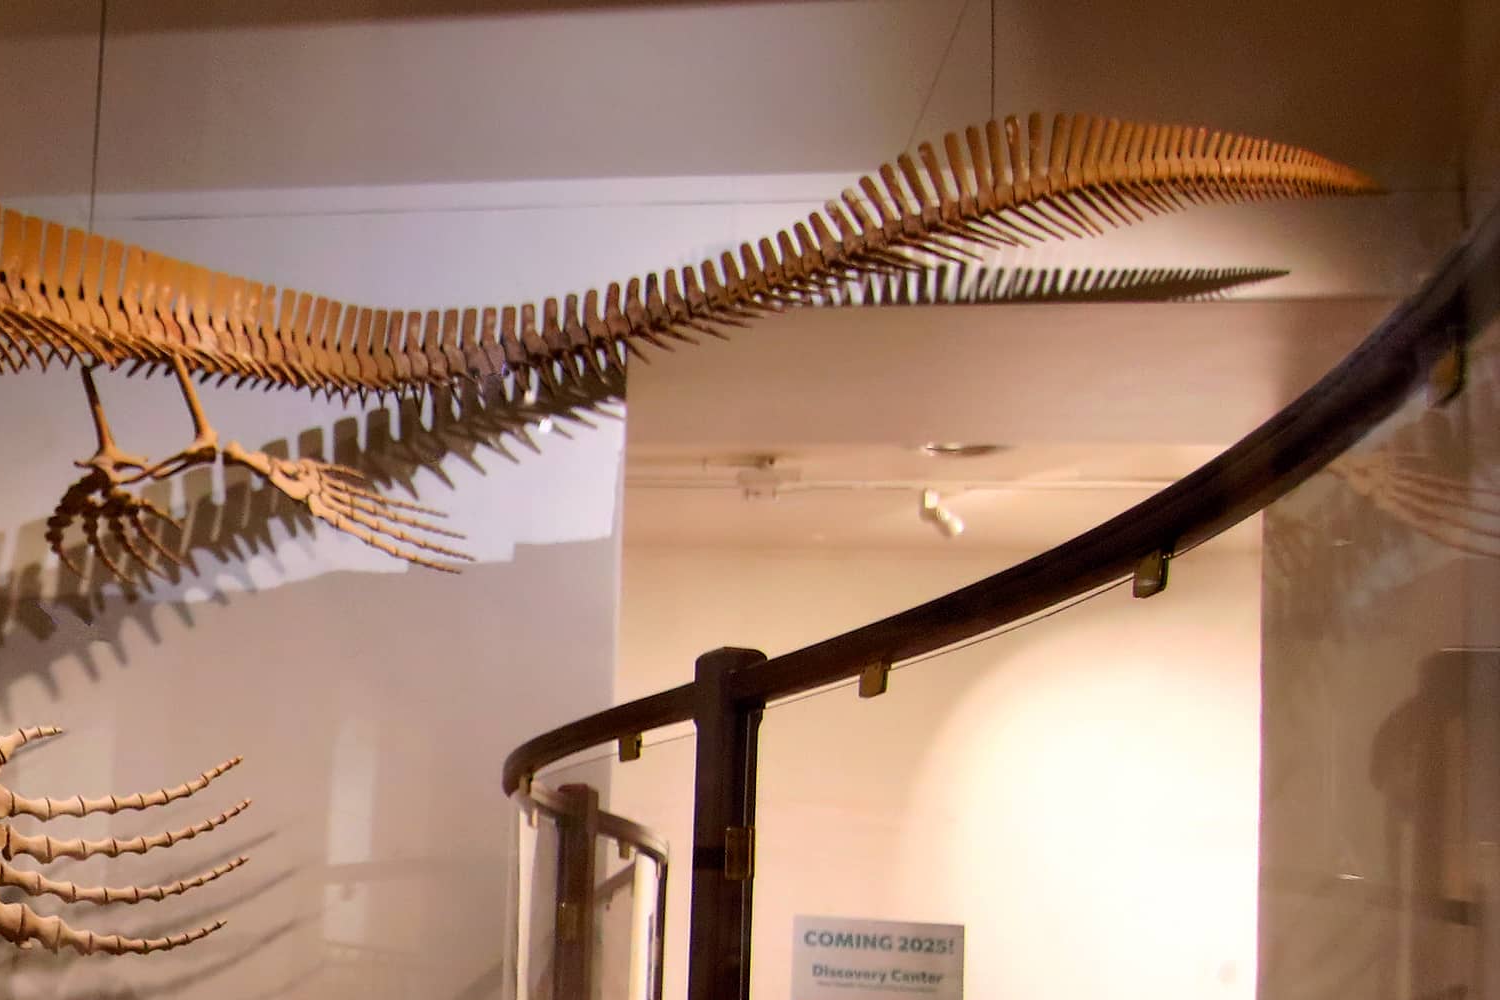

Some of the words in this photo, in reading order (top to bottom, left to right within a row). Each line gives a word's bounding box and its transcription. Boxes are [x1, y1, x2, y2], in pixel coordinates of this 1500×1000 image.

[803, 930, 893, 950] COMING
[897, 935, 955, 955] 2025!
[811, 963, 886, 983] Discovery
[891, 969, 944, 985] Center
